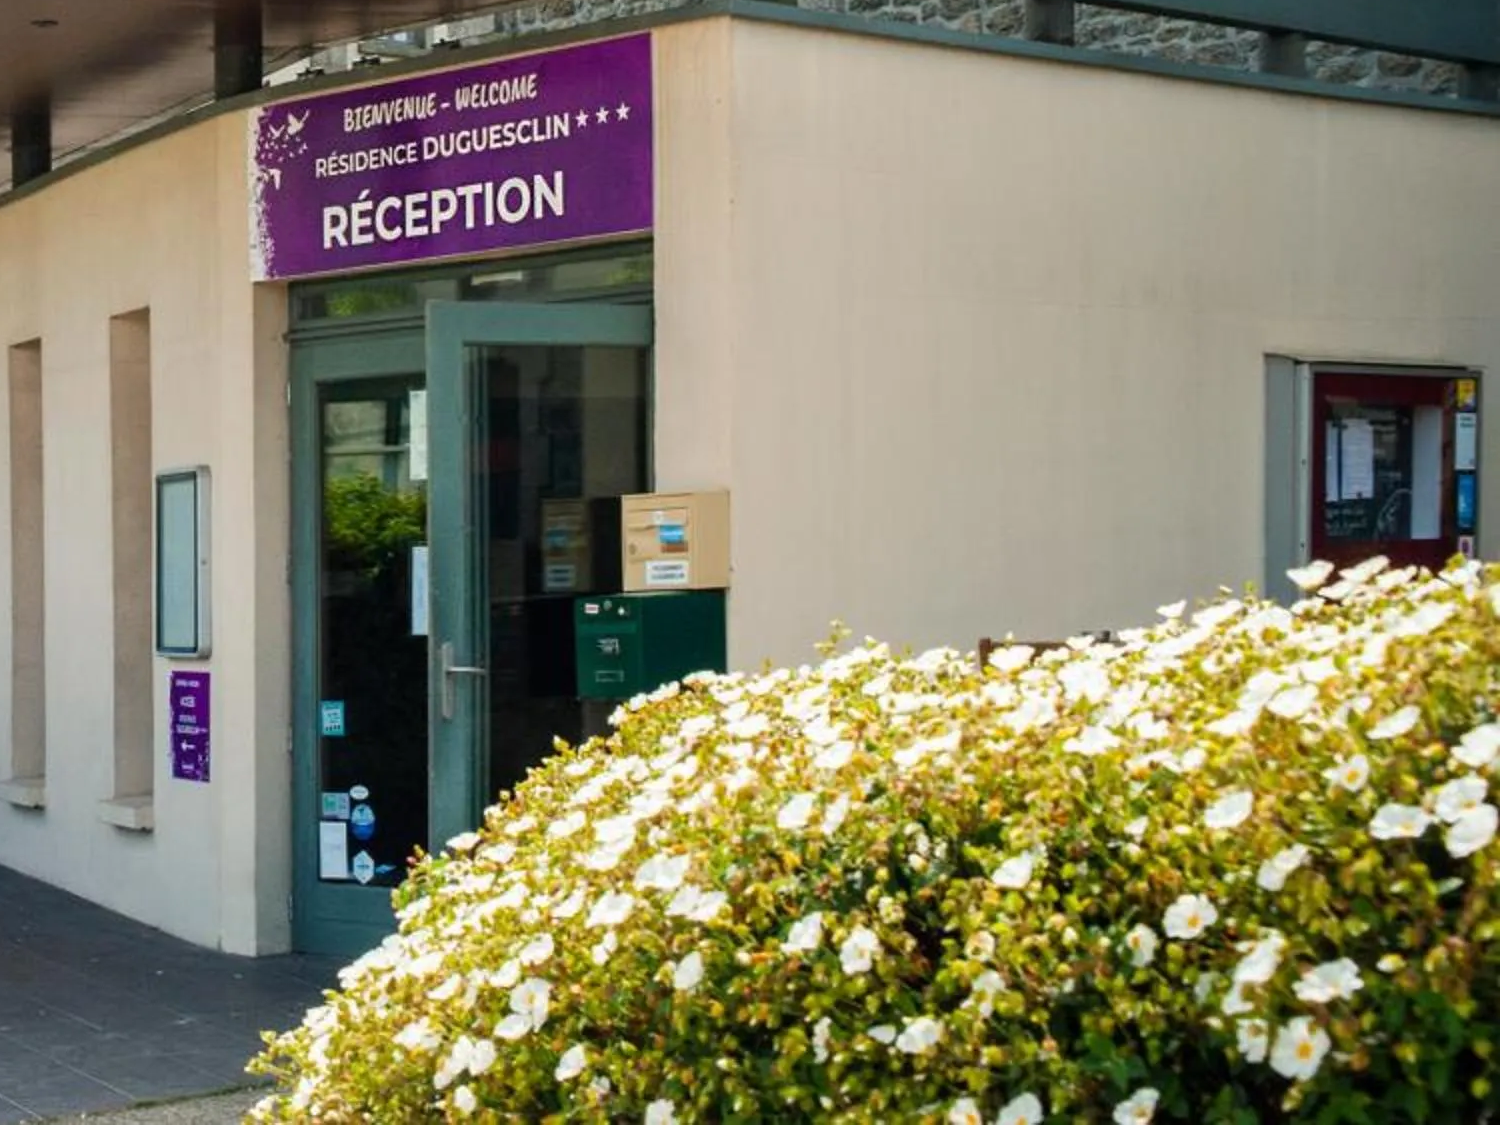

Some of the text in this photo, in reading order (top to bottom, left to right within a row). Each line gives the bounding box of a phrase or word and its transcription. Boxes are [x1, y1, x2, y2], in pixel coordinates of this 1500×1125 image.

[342, 92, 437, 133] BIENVENUE
[455, 74, 538, 111] WELCOME
[315, 112, 570, 178] RÉSIDENCE DUGUESCLIN
[322, 170, 565, 250] RÉCEPTION
